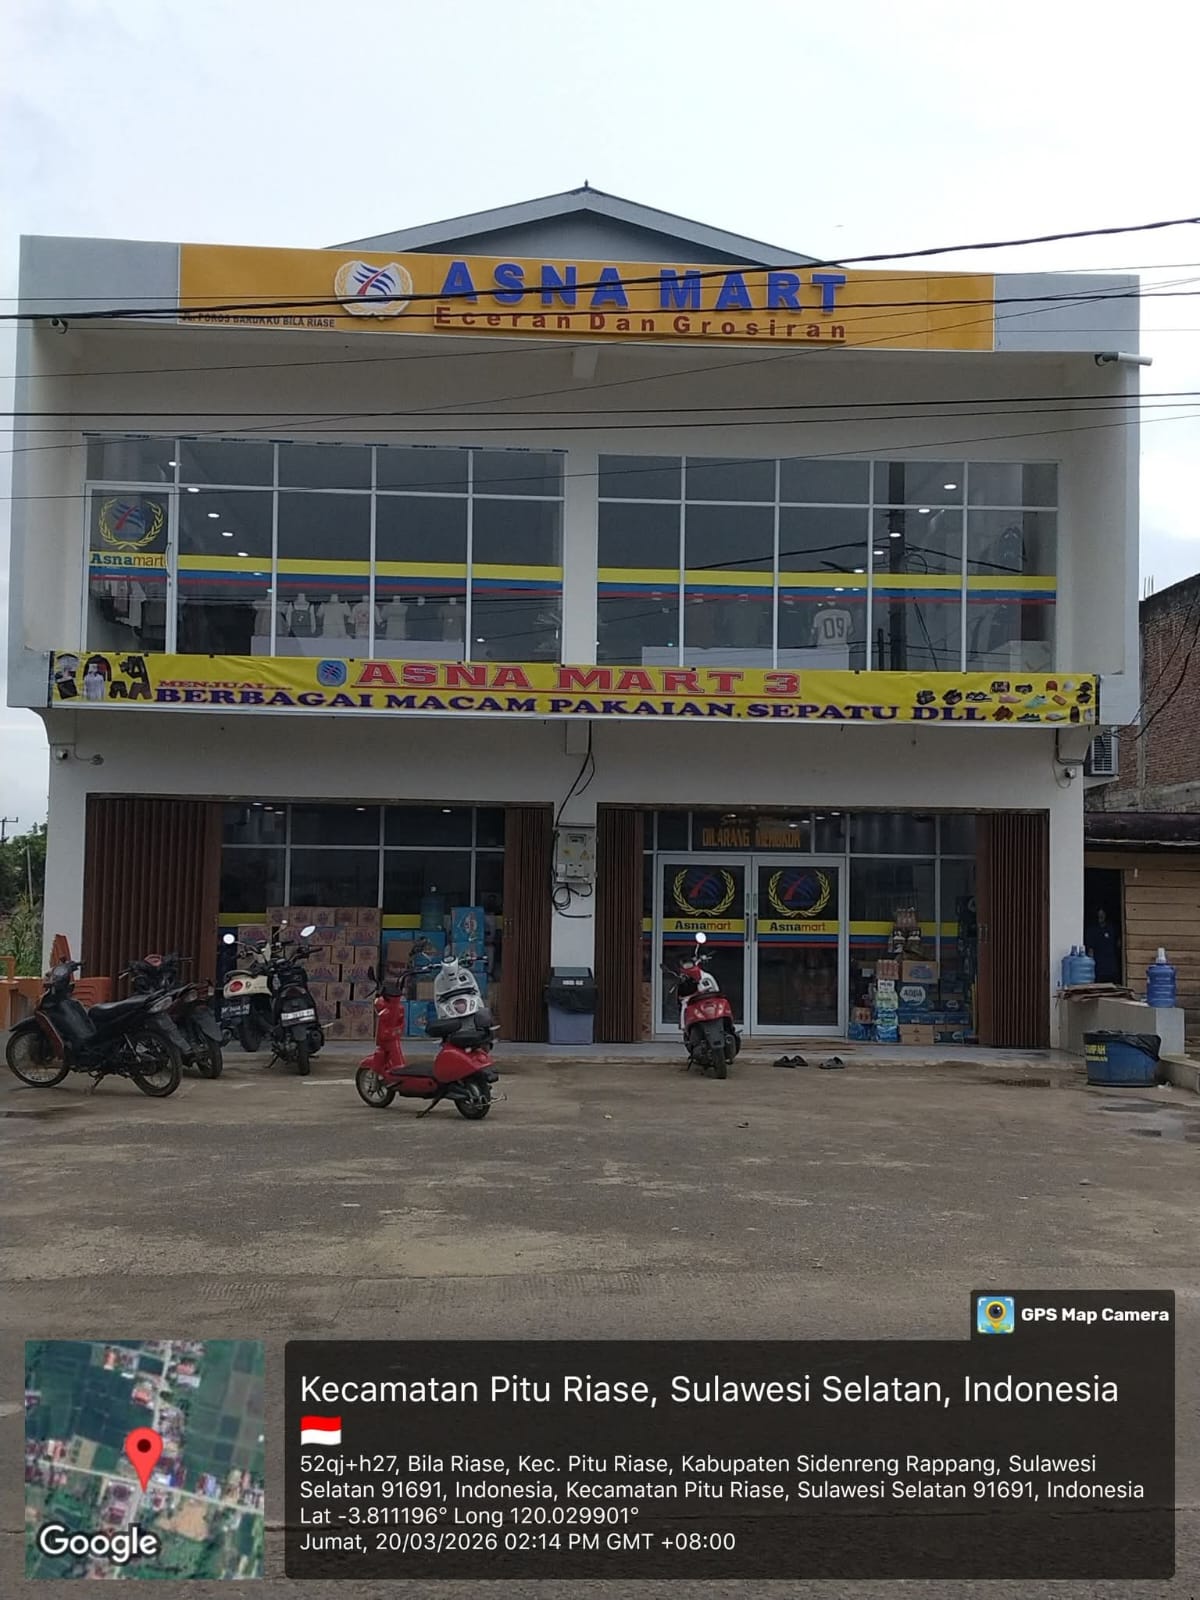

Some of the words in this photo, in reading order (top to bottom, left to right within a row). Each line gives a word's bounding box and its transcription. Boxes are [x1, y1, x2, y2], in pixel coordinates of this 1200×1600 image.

[440, 261, 629, 310] ASNA
[658, 269, 848, 316] MART
[282, 316, 304, 327] BILA
[307, 317, 335, 328] RIASE
[436, 306, 570, 329] Eceran
[590, 314, 654, 332] Dan
[673, 315, 845, 338] Grosiran
[90, 553, 165, 567] Asnamart
[355, 661, 534, 689] ASNA
[553, 666, 745, 694] MART
[764, 671, 801, 696] 3
[155, 687, 374, 708] BERBAGAI
[385, 694, 538, 713] MACAM
[911, 706, 987, 722] DLL
[674, 920, 732, 931] Asnamart
[769, 921, 826, 933] Asnamart
